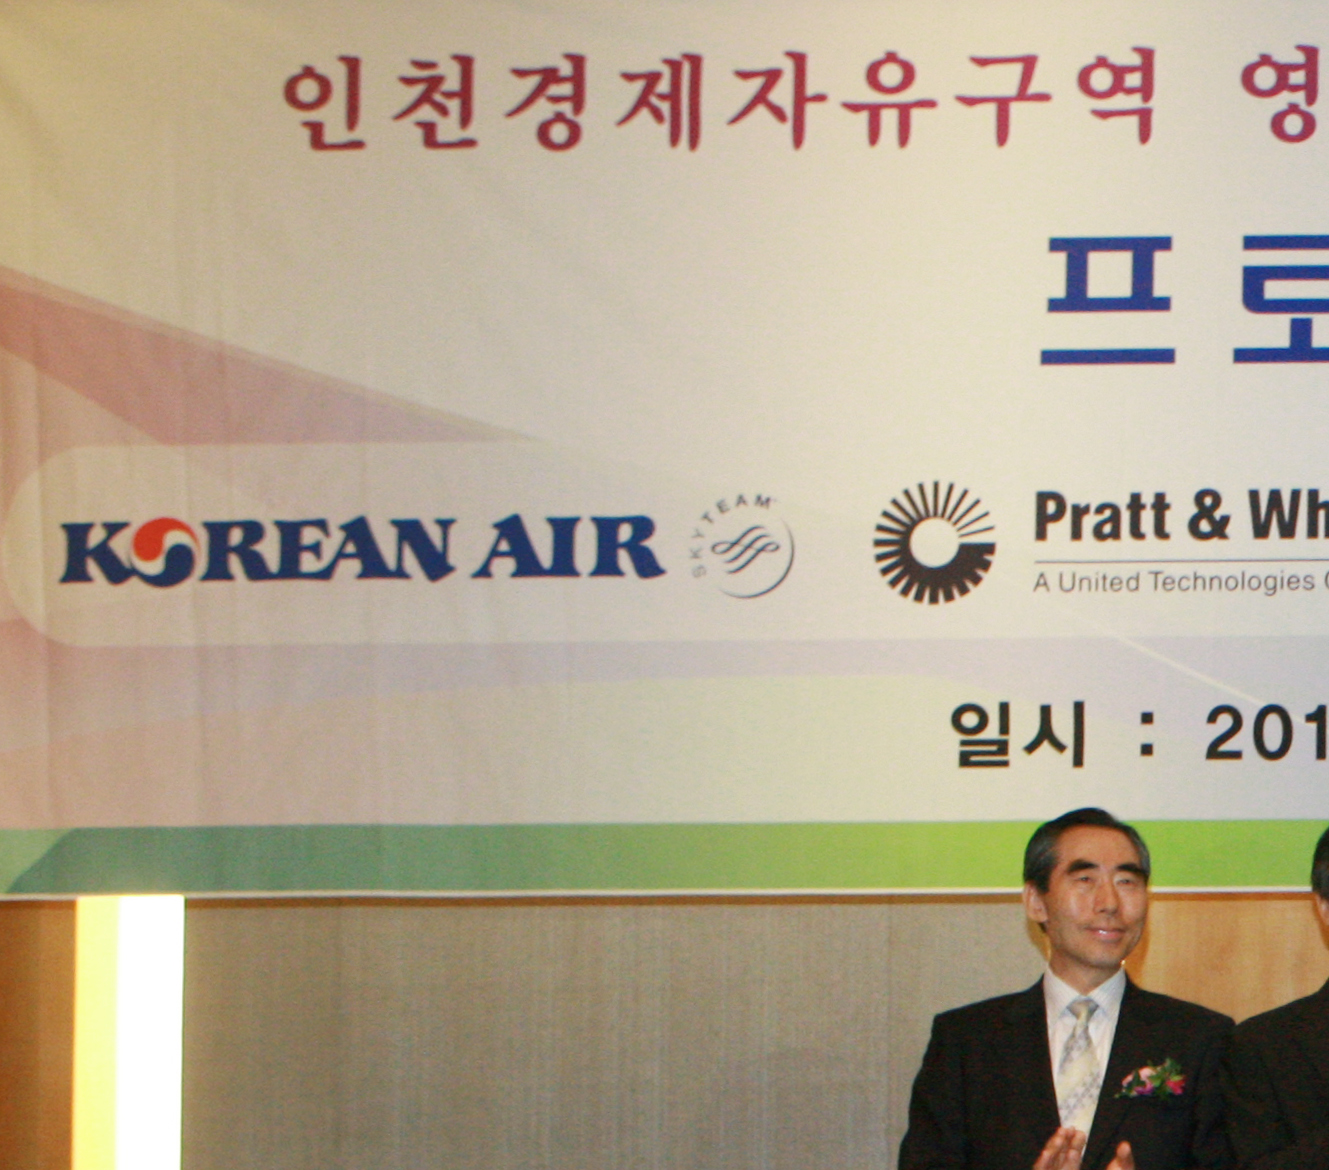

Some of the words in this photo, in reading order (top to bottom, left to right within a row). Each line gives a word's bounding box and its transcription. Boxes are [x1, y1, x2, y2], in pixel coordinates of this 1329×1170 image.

[282, 46, 1155, 153] 인천경제자유구역
[1035, 490, 1171, 543] Pratt
[1187, 487, 1231, 542] &
[59, 514, 457, 588] KOREAN
[470, 513, 666, 579] AIR
[1033, 572, 1050, 591] A
[1059, 573, 1140, 593] United
[1151, 570, 1316, 597] Technologies
[950, 700, 1085, 769] 일시
[1139, 711, 1155, 758] :
